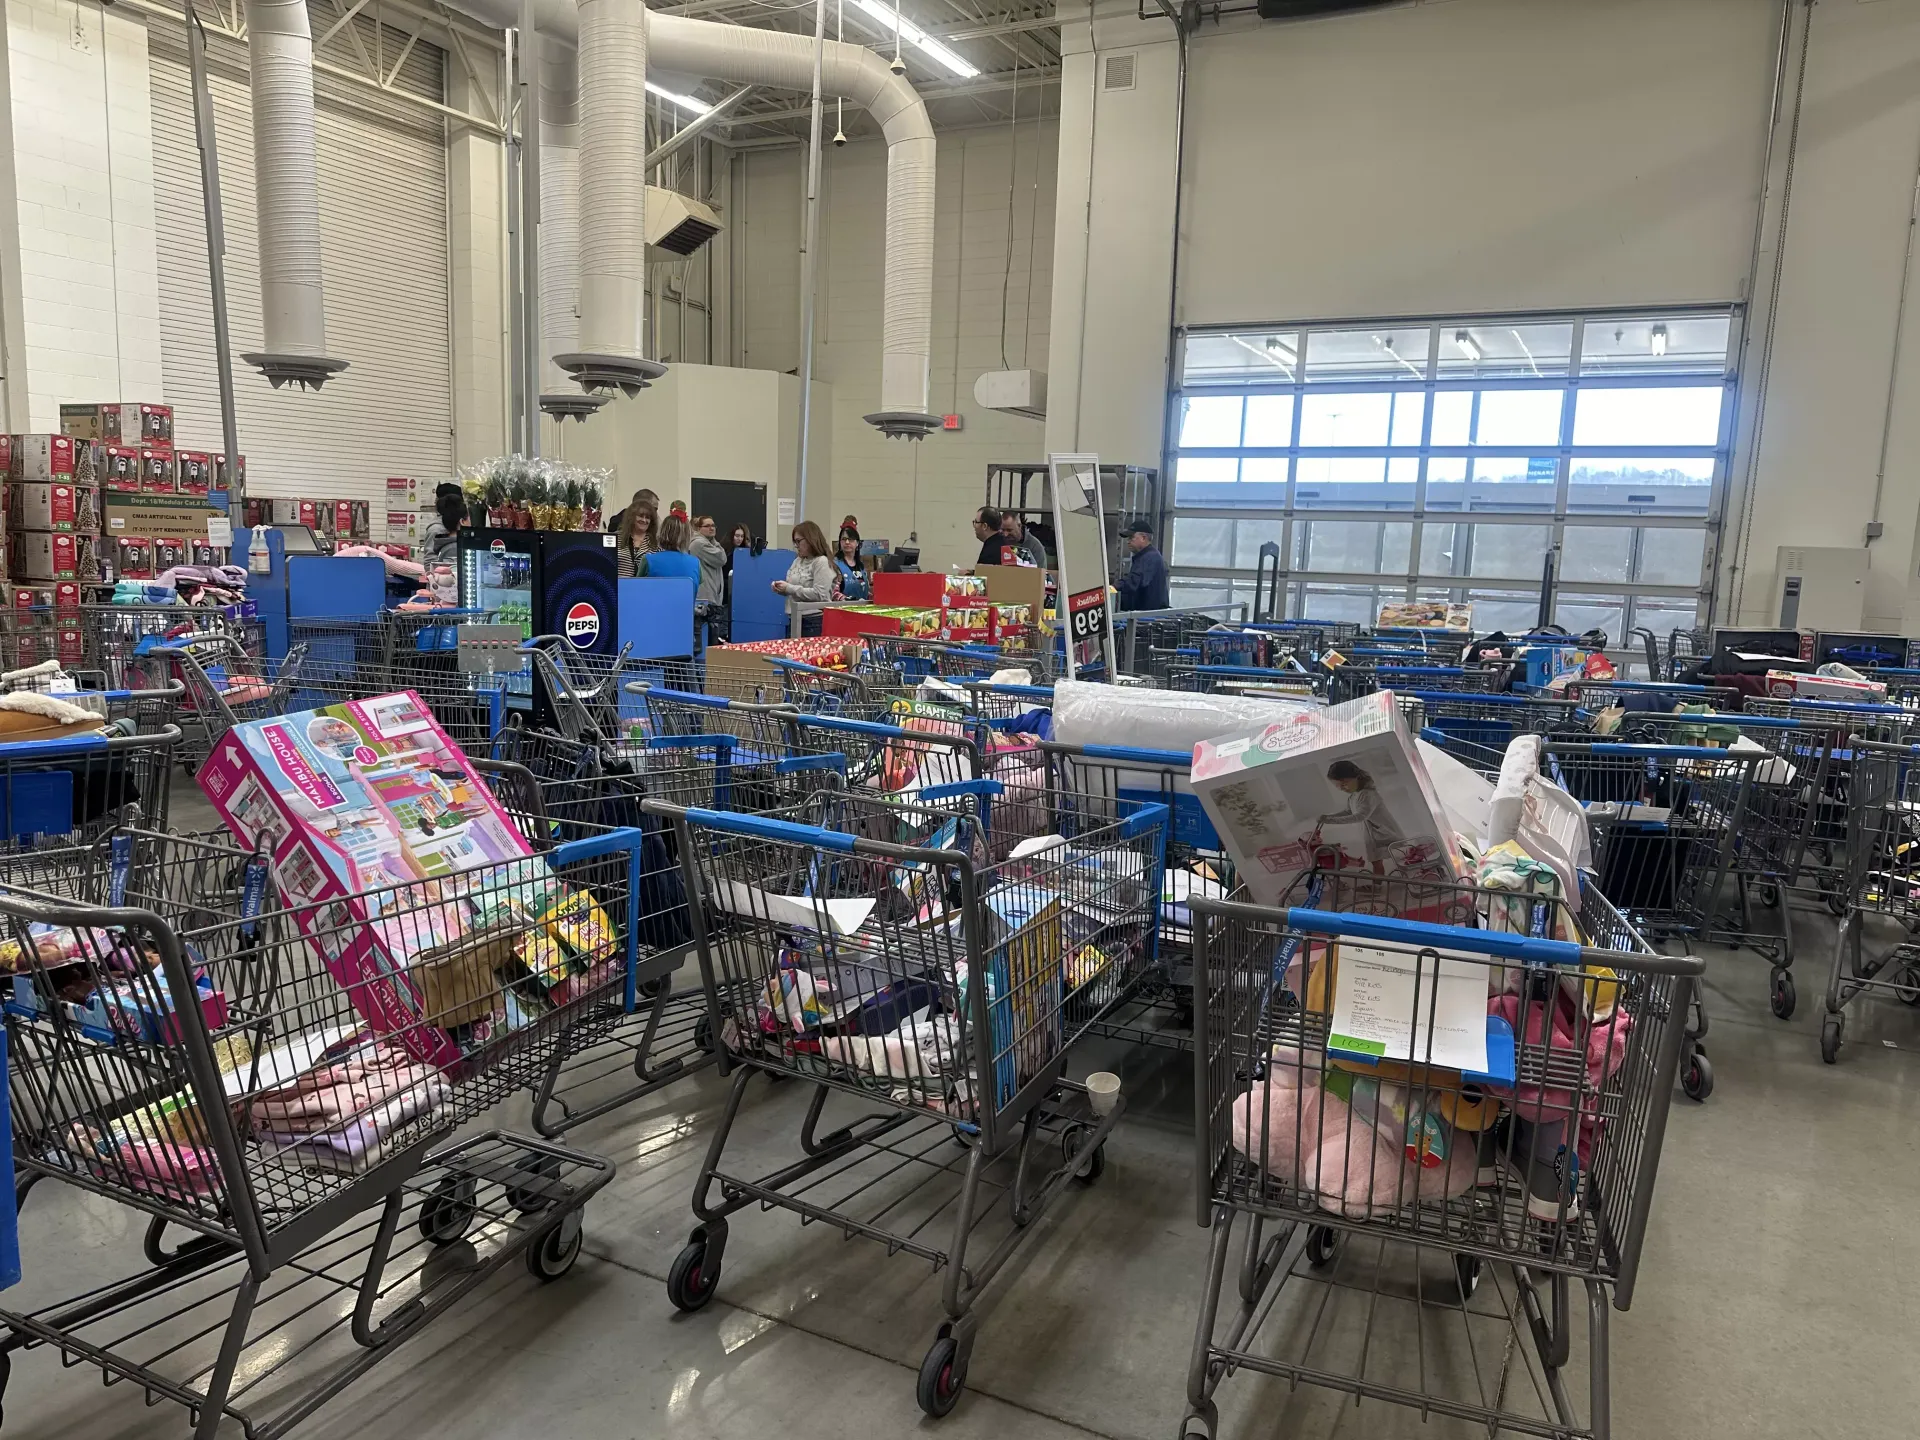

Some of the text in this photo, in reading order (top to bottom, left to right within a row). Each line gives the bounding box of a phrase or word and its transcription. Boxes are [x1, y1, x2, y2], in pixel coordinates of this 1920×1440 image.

[568, 621, 597, 631] PEPSI
[286, 726, 312, 760] ACCESSORIES
[367, 726, 380, 741] FOLD
[1266, 728, 1304, 748] Sweet
[266, 729, 325, 806] MALIBU HOUSE
[322, 776, 338, 796] ROOMS
[246, 880, 260, 917] Walmart
[1342, 1038, 1370, 1050] 105
